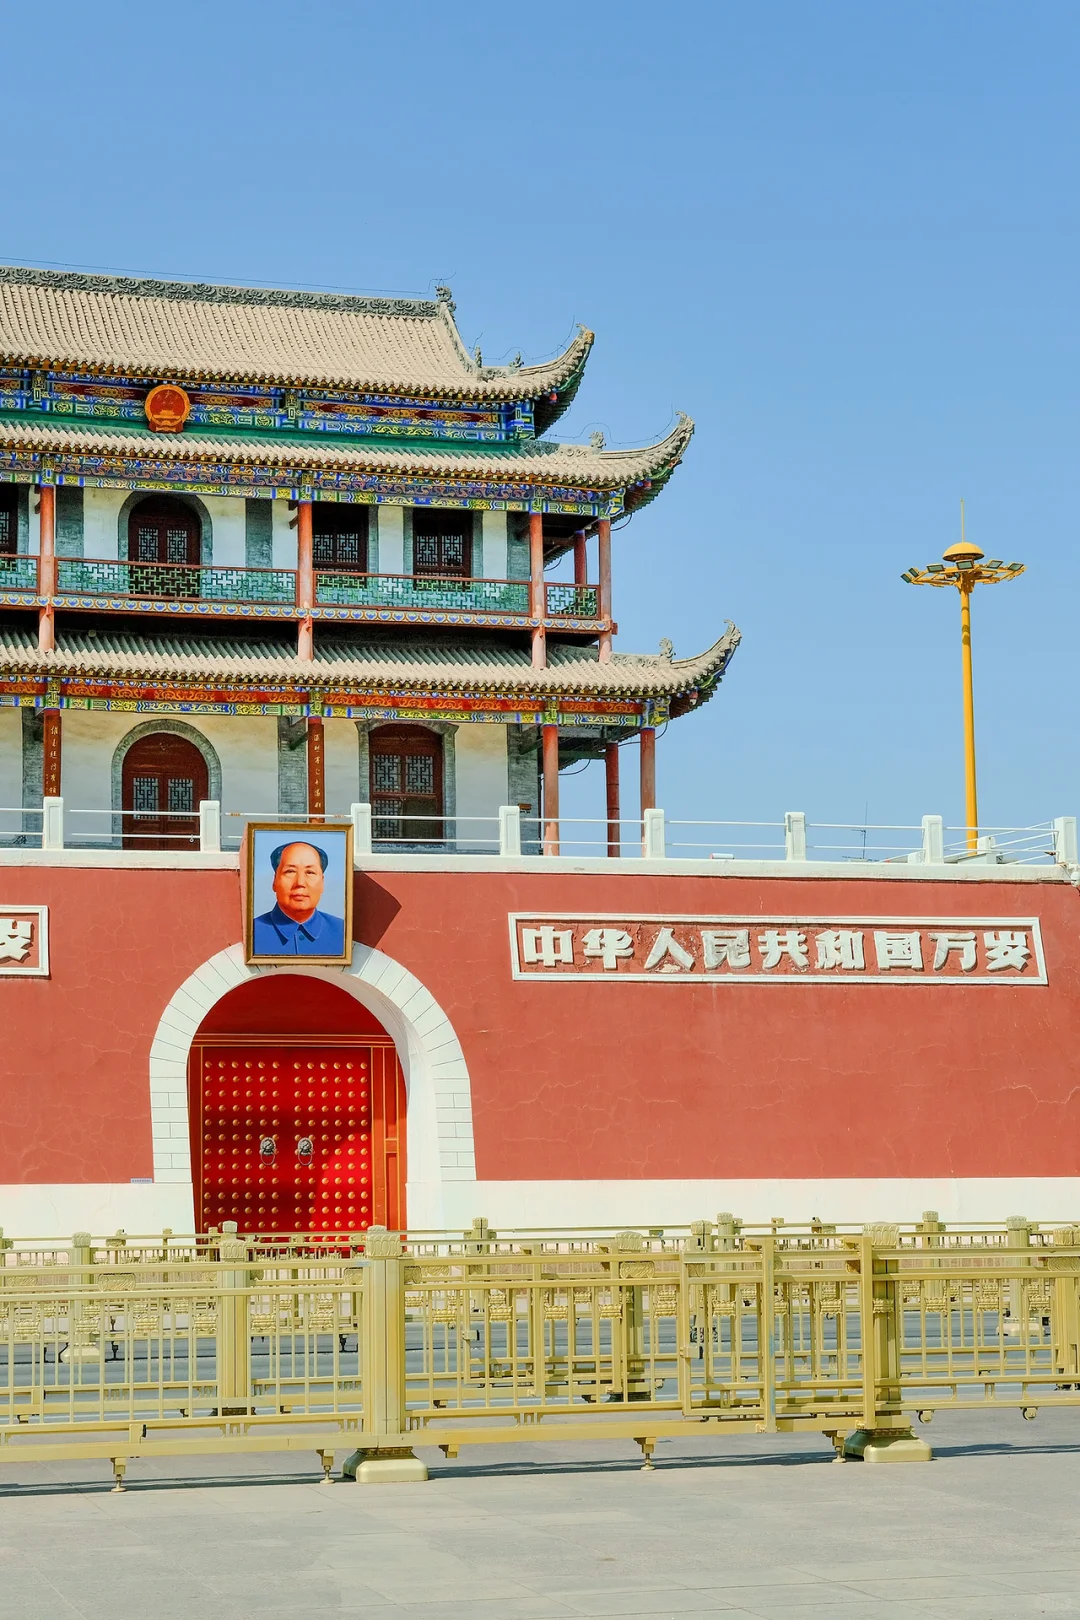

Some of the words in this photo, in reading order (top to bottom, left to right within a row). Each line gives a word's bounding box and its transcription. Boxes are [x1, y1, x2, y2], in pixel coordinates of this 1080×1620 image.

[0, 918, 33, 961] 岁
[522, 925, 1031, 972] 中华人民共和国万岁
